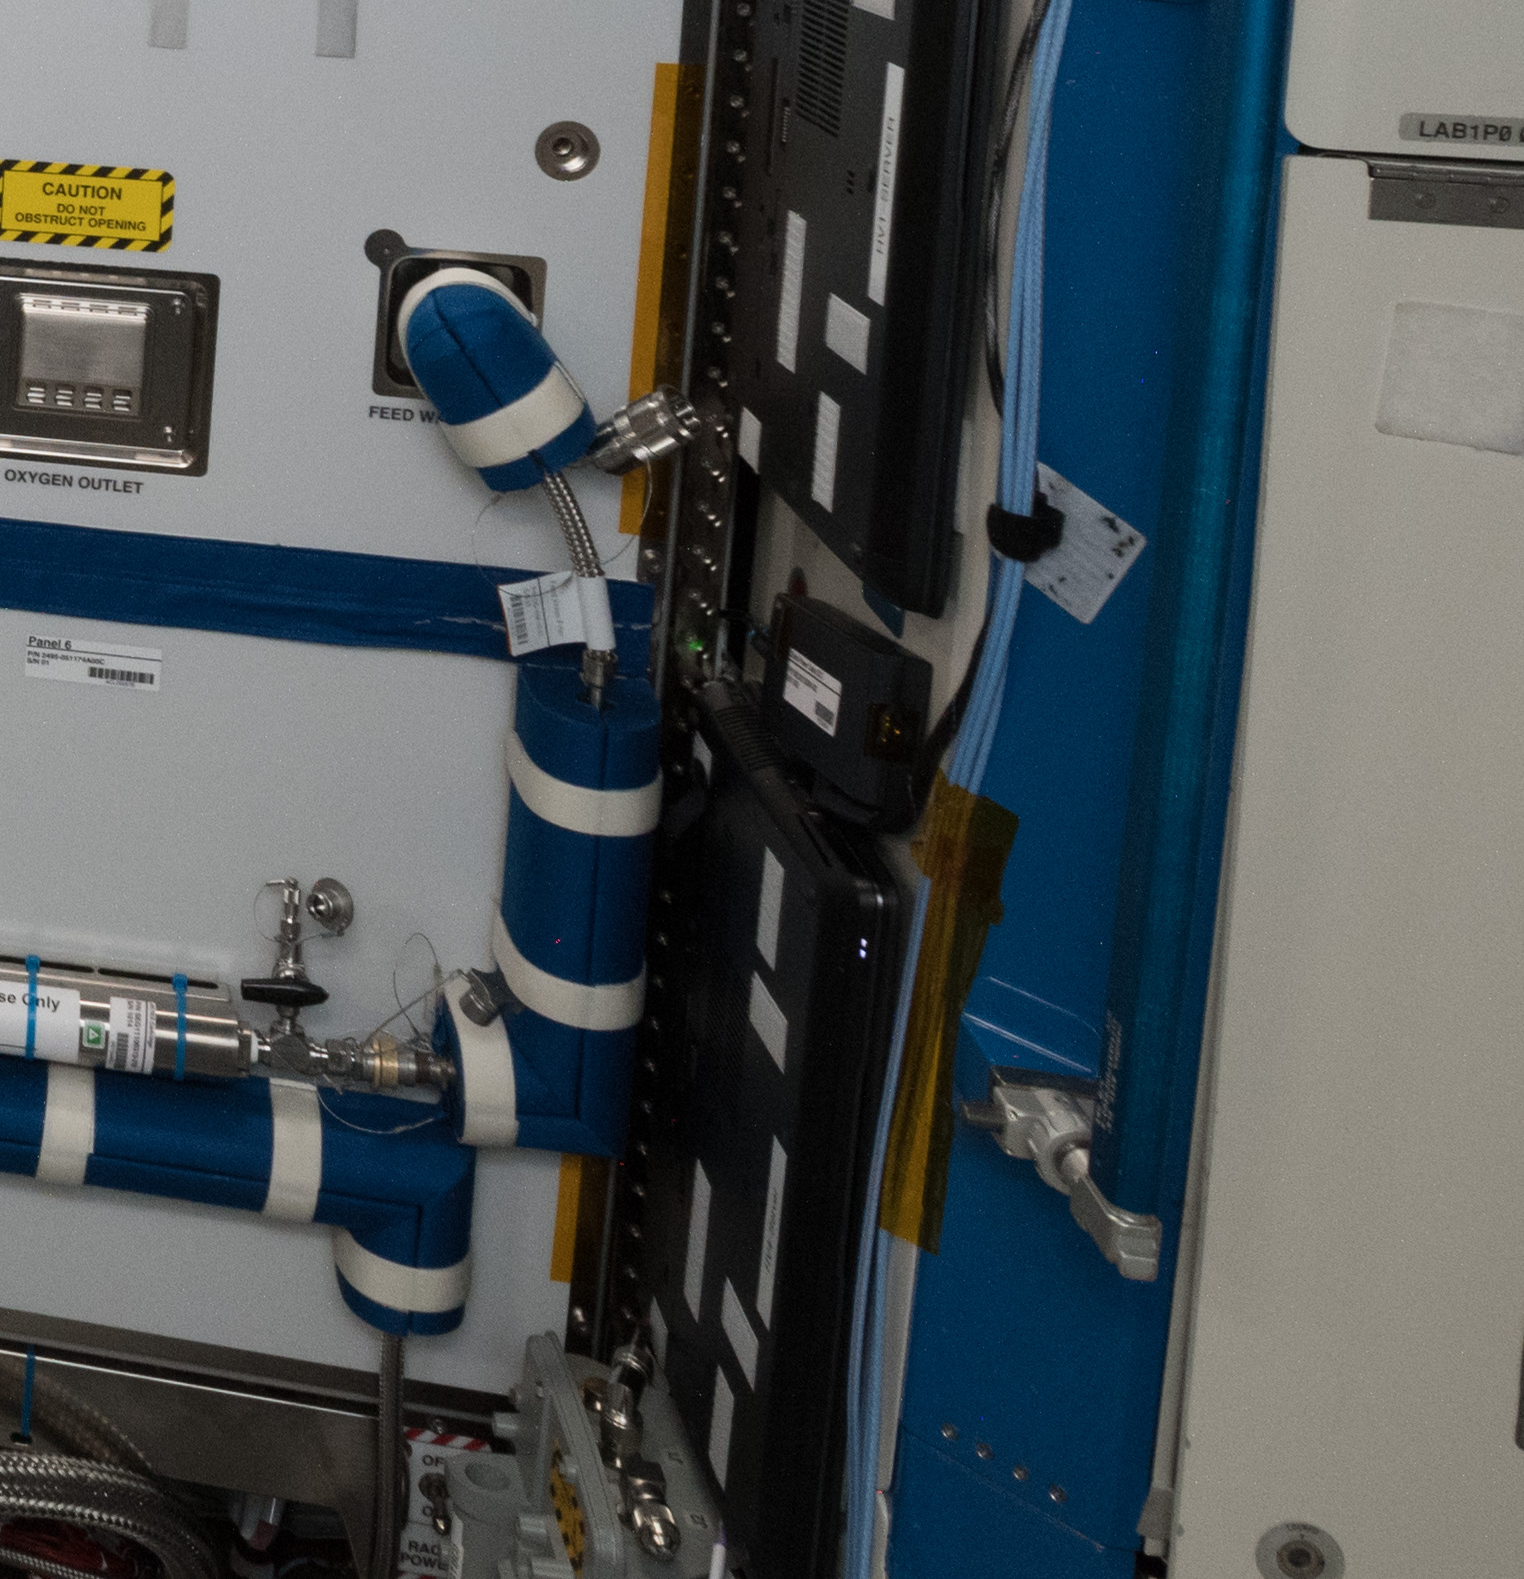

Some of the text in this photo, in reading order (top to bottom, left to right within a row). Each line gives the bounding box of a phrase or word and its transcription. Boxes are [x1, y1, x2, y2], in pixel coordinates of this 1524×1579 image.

[42, 182, 122, 200] CAUTION
[57, 203, 106, 216] DO NOT
[15, 212, 146, 232] OBSTRUCT OPENING
[369, 405, 415, 423] FEED
[4, 469, 144, 494] OXYGEN OUTLET
[29, 636, 61, 649] Panel
[422, 1454, 445, 1468] OF
[408, 1540, 442, 1556] RAC
[402, 1553, 449, 1571] POWE
